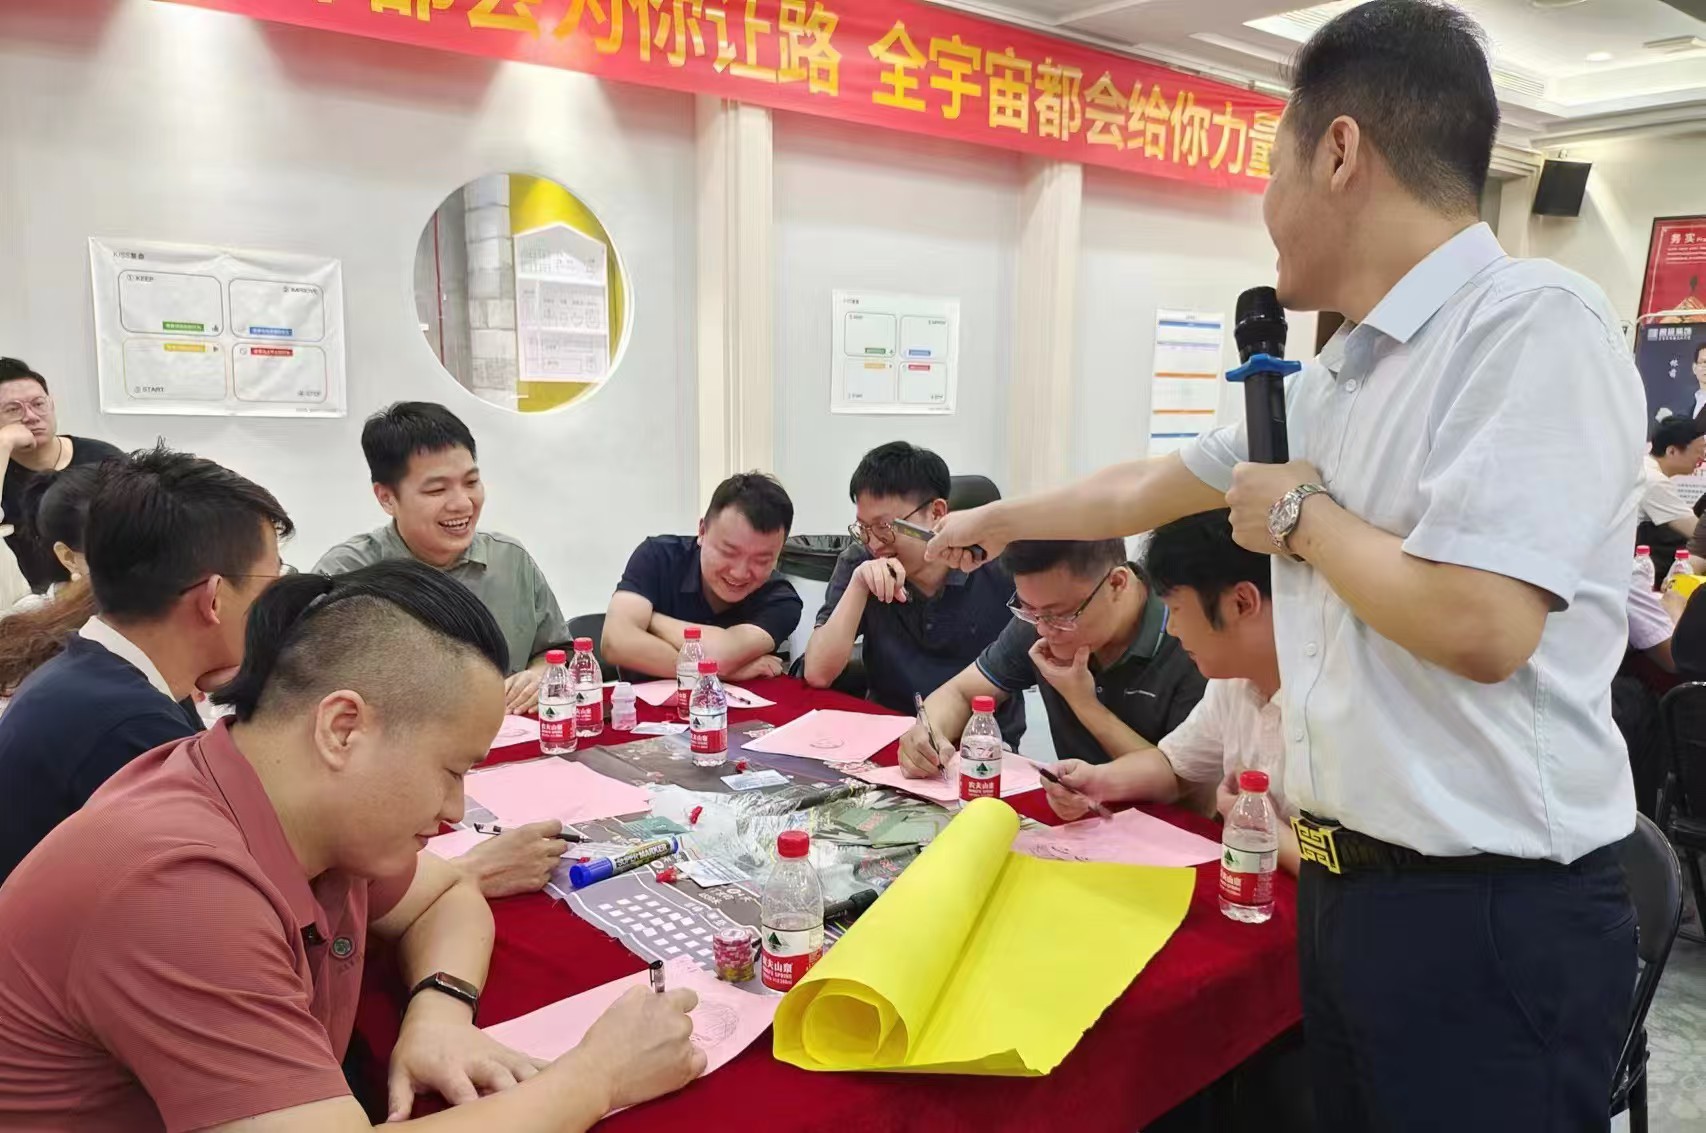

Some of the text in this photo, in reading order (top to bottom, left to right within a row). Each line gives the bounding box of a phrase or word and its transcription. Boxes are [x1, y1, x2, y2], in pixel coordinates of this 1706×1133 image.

[370, 0, 1281, 179] 为你让路 全宇宙都会给你力量
[638, 842, 669, 858] MARKER
